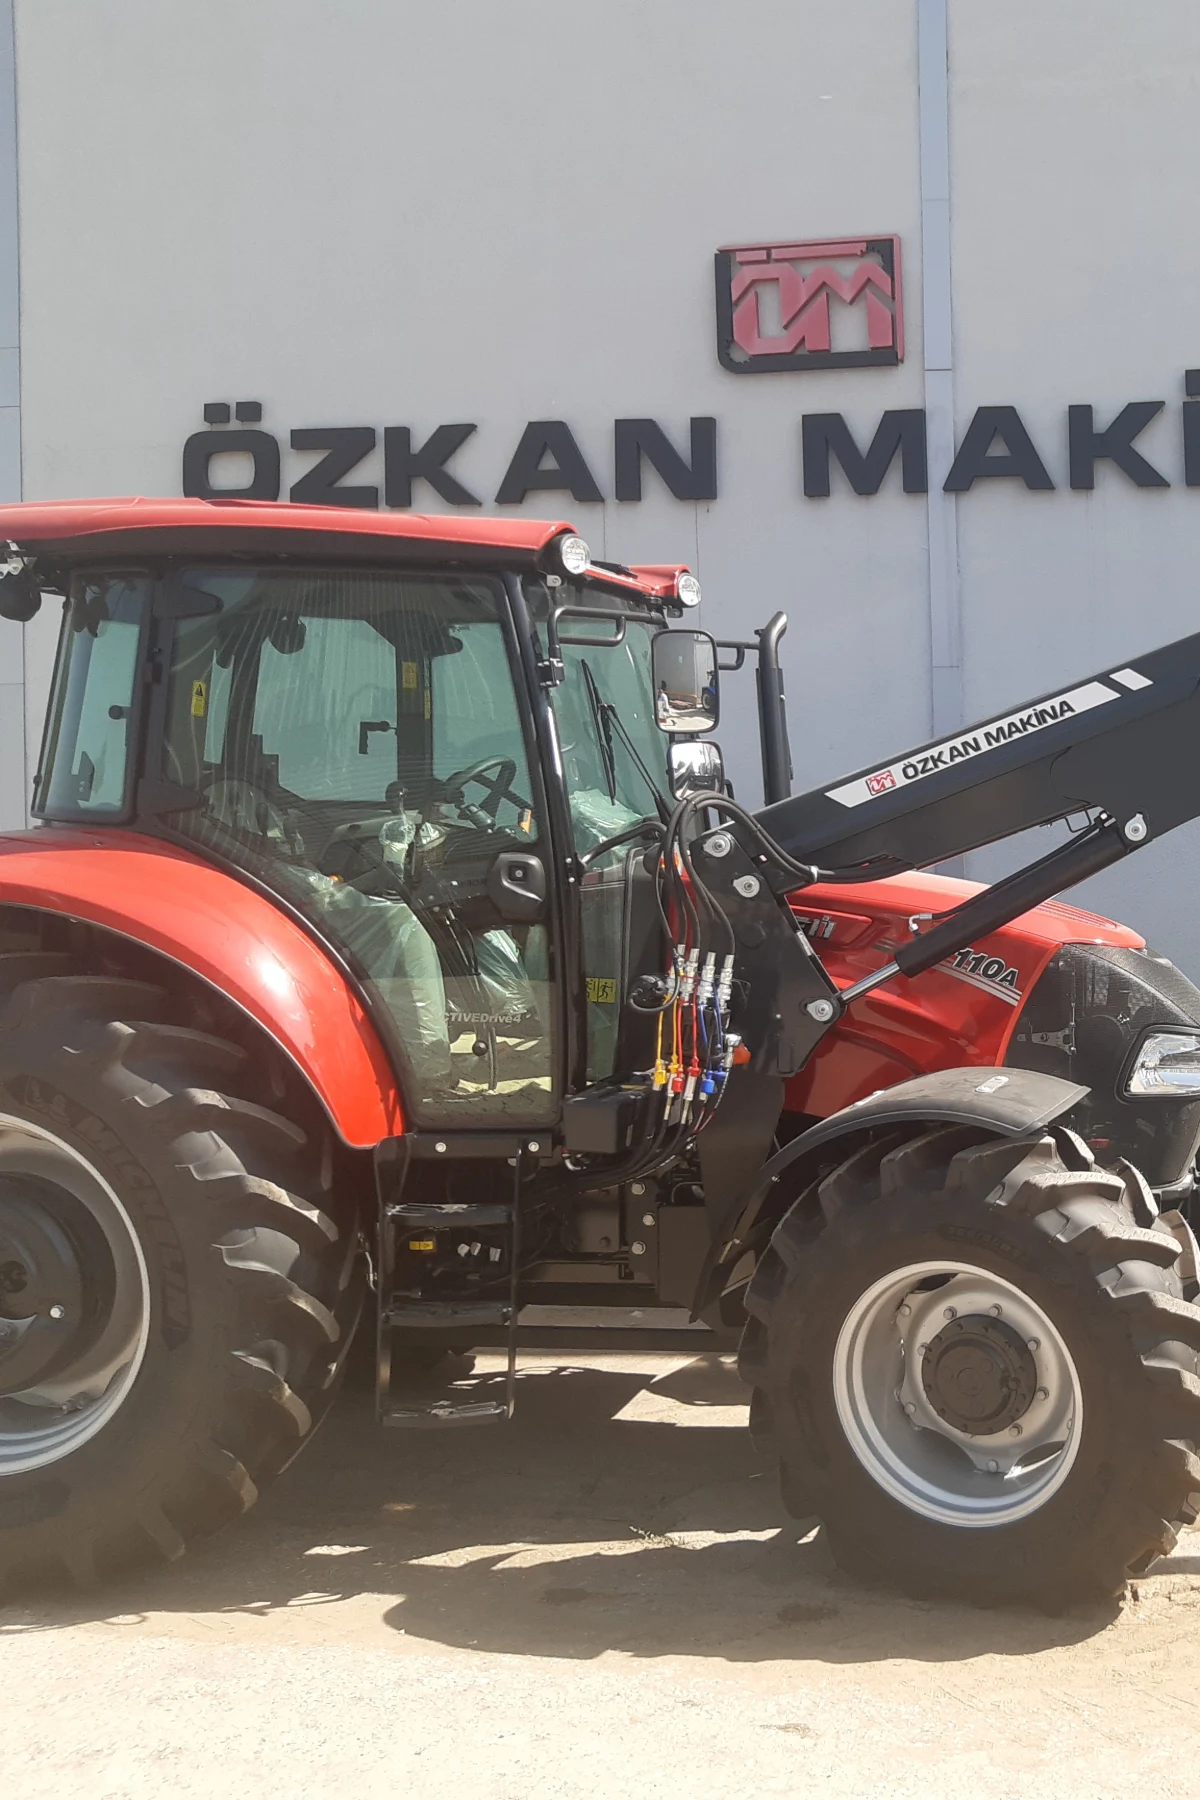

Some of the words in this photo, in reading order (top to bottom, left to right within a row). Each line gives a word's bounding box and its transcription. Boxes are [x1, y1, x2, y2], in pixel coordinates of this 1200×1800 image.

[183, 402, 718, 508] ÖZKAN
[901, 737, 982, 781] ÖZKAN
[983, 700, 1077, 748] MAKİNA
[952, 947, 1019, 988] 110A
[443, 1012, 522, 1024] CTIVEDrive4
